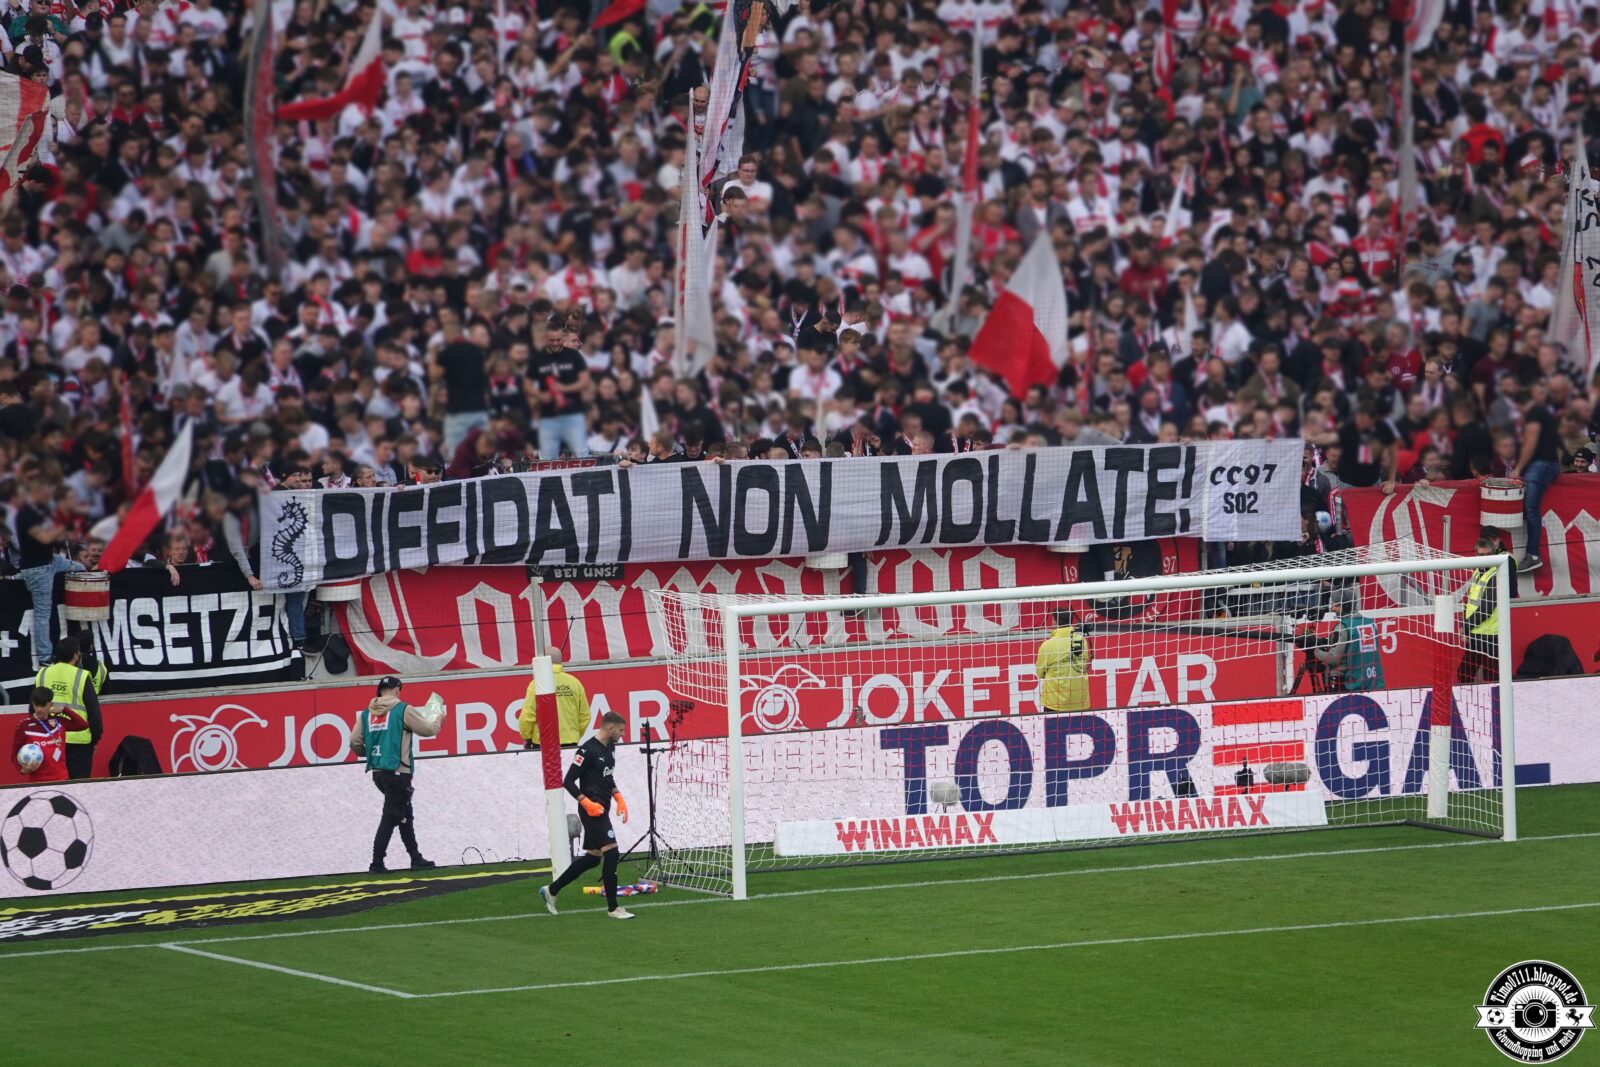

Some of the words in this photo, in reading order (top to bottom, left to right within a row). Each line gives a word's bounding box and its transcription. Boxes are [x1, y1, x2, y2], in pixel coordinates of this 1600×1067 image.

[1210, 463, 1278, 486] CC97
[322, 469, 632, 581] DIFFIDATI
[679, 461, 832, 558] NON
[874, 445, 1197, 546] MOLLATE!
[1222, 490, 1259, 515] S02
[553, 567, 578, 579] BEI
[583, 565, 619, 578] UNS!
[1063, 565, 1078, 583] 19
[1162, 555, 1178, 574] 97
[1366, 666, 1377, 679] 06
[827, 653, 1217, 728] JOKERTAR
[1110, 795, 1270, 835] WINAMAX
[835, 812, 999, 852] WINAMAX
